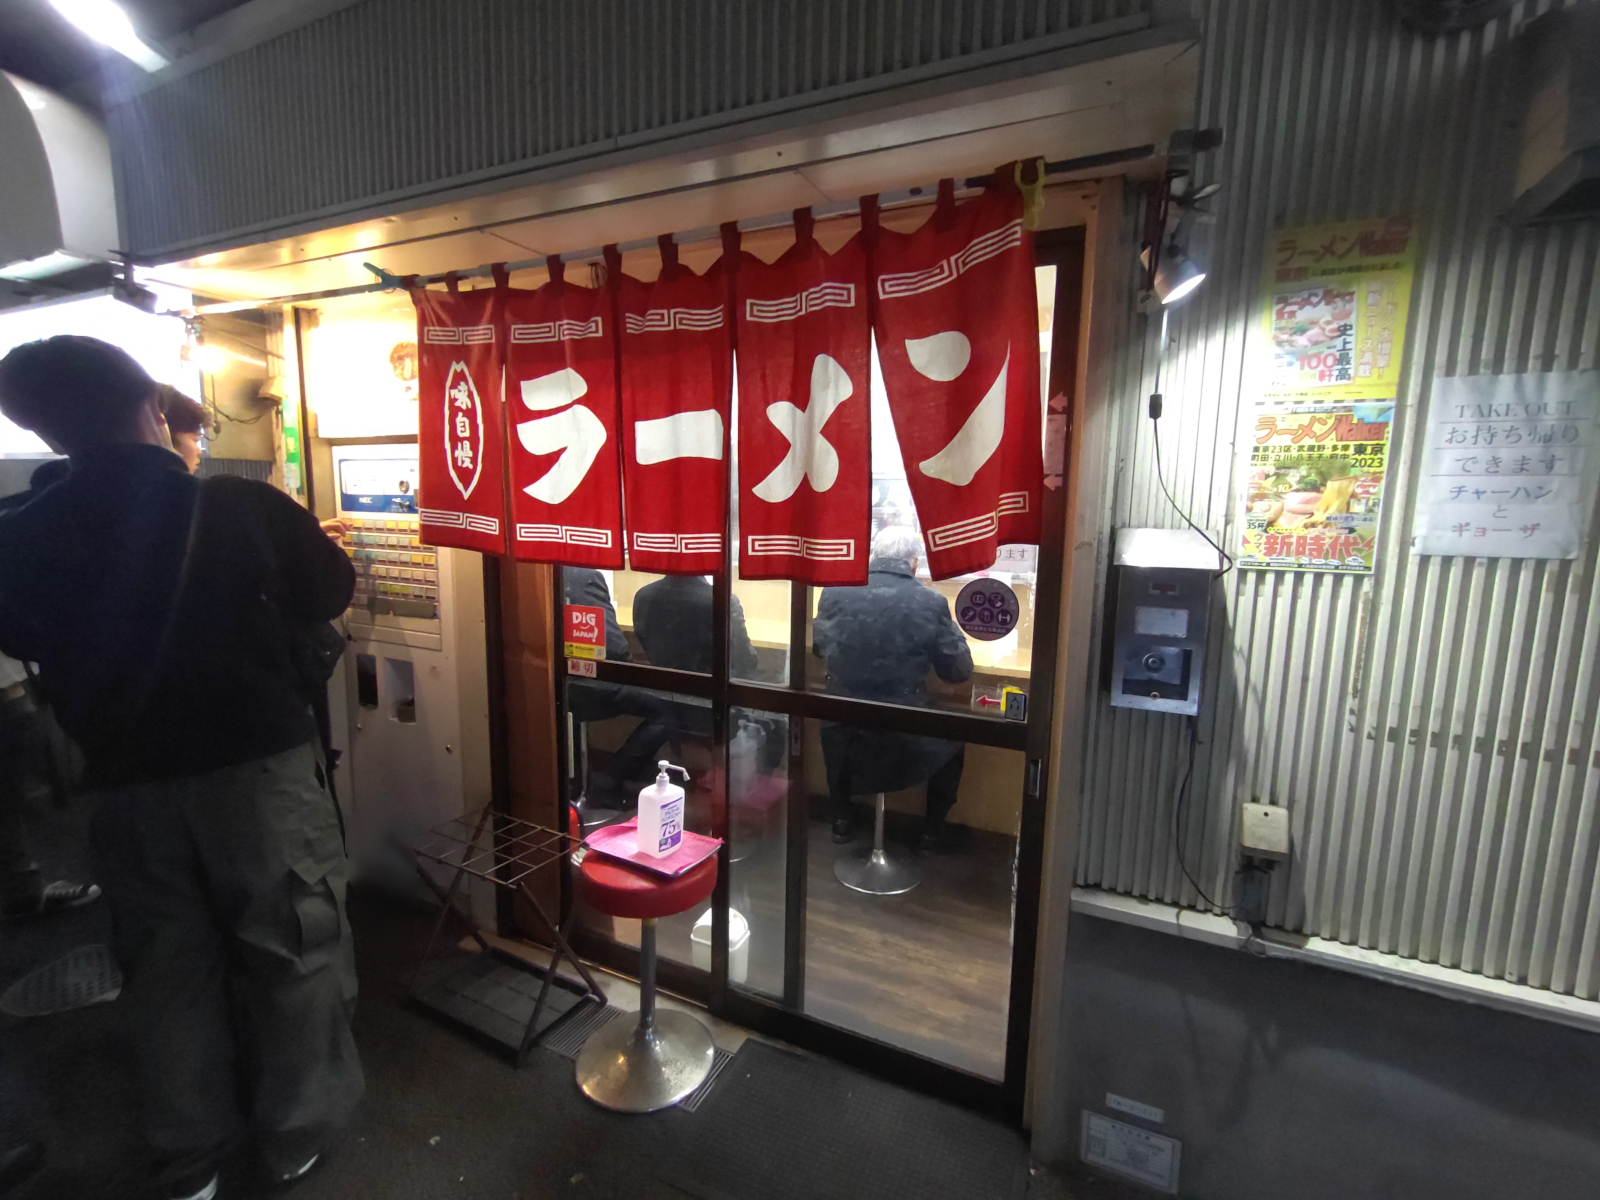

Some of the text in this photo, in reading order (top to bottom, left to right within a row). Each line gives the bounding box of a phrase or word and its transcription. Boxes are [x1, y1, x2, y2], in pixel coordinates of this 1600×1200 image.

[1298, 352, 1338, 371] 100
[516, 331, 1010, 504] ラーメン
[1455, 401, 1577, 418] TAKE OUT
[450, 380, 475, 470] 味自慢
[1445, 424, 1579, 445] お持ち帰り
[1352, 443, 1385, 456] 東京
[1350, 457, 1384, 468] 2023
[1455, 453, 1564, 474] できます
[1450, 485, 1554, 500] チャーハン
[1492, 504, 1508, 519] と
[1451, 522, 1541, 539] ギョーザ
[1263, 533, 1362, 559] 新時代
